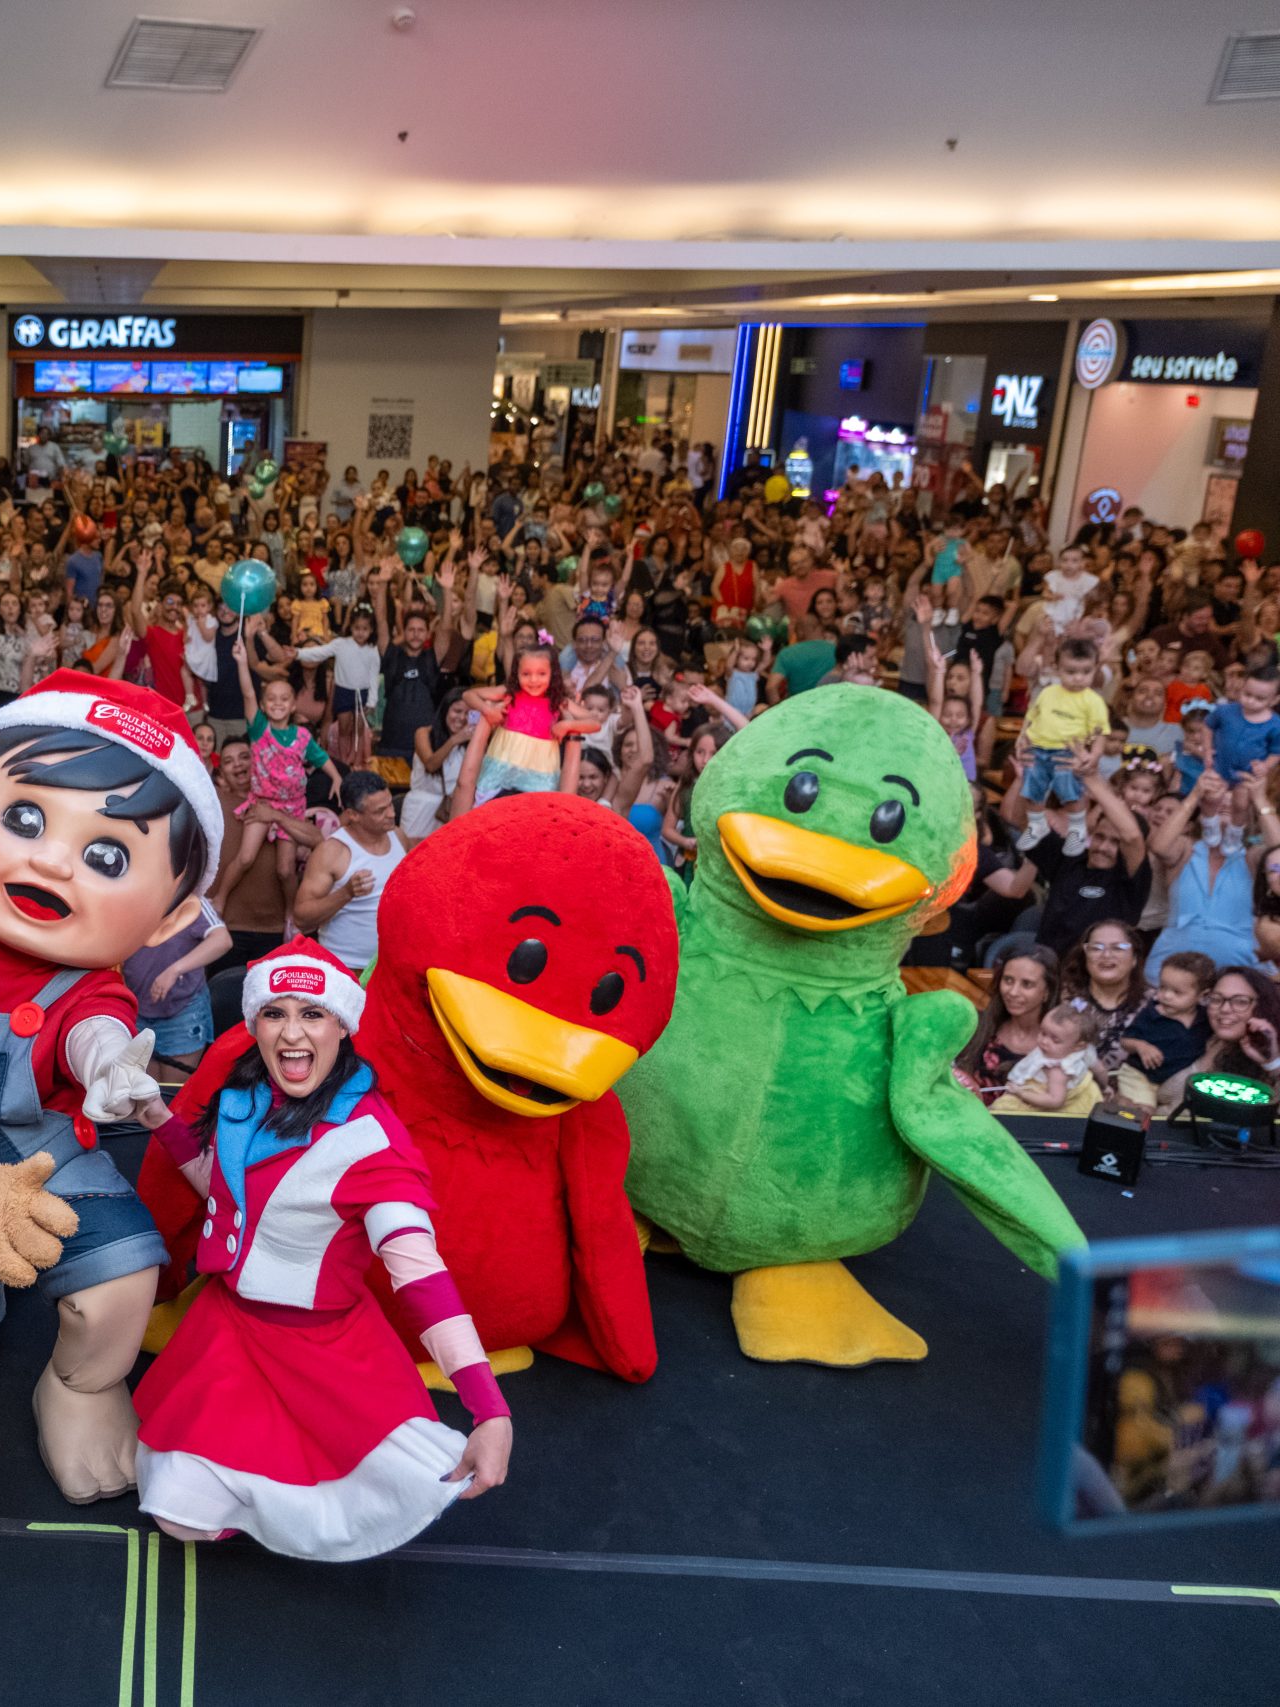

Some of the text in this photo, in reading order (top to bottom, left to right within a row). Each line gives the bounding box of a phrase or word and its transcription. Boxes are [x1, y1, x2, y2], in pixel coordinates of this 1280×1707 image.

[1164, 350, 1238, 382] sorvete
[113, 709, 171, 747] BOULEVARD
[116, 719, 161, 747] SHOPPING
[283, 972, 323, 981] BOULEVARD
